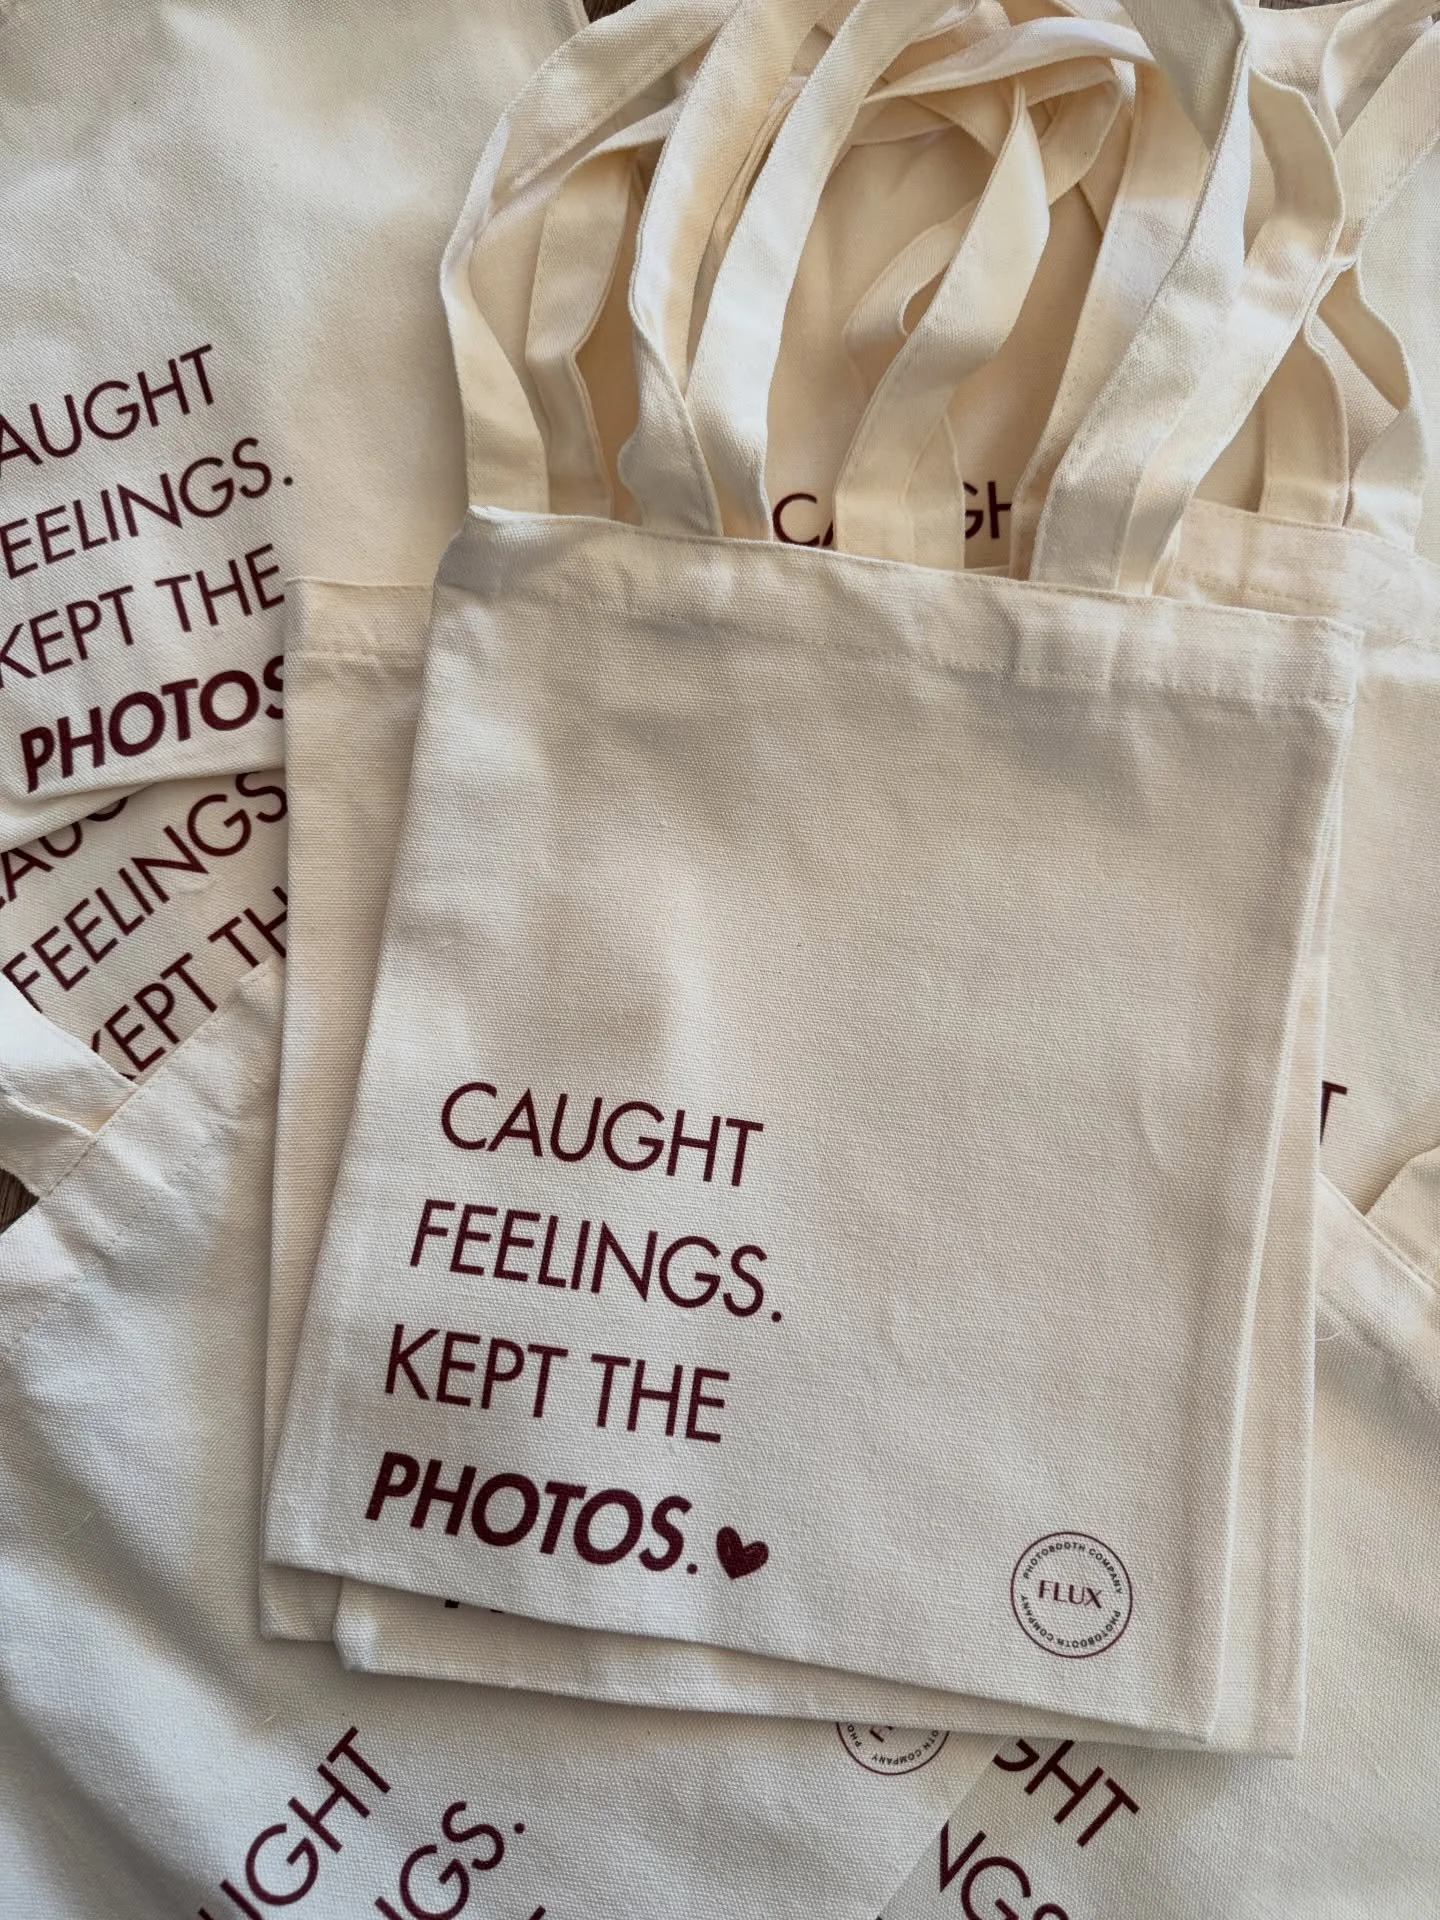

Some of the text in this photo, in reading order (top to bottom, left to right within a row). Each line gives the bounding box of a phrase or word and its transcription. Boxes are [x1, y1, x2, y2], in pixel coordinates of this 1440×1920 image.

[155, 544, 285, 632] THE
[441, 1082, 763, 1186] CAUGHT
[410, 1199, 781, 1322] FEELINGS.
[385, 1324, 730, 1443] KEPT THE
[365, 1451, 697, 1574] PHOTOS.
[1023, 1541, 1123, 1595] PHOTOBOOTH COMPANY
[1038, 1579, 1103, 1609] FLUX
[1020, 1594, 1121, 1648] PHOTOBOOTH COMPANY
[871, 1748, 922, 1765] COMPANY
